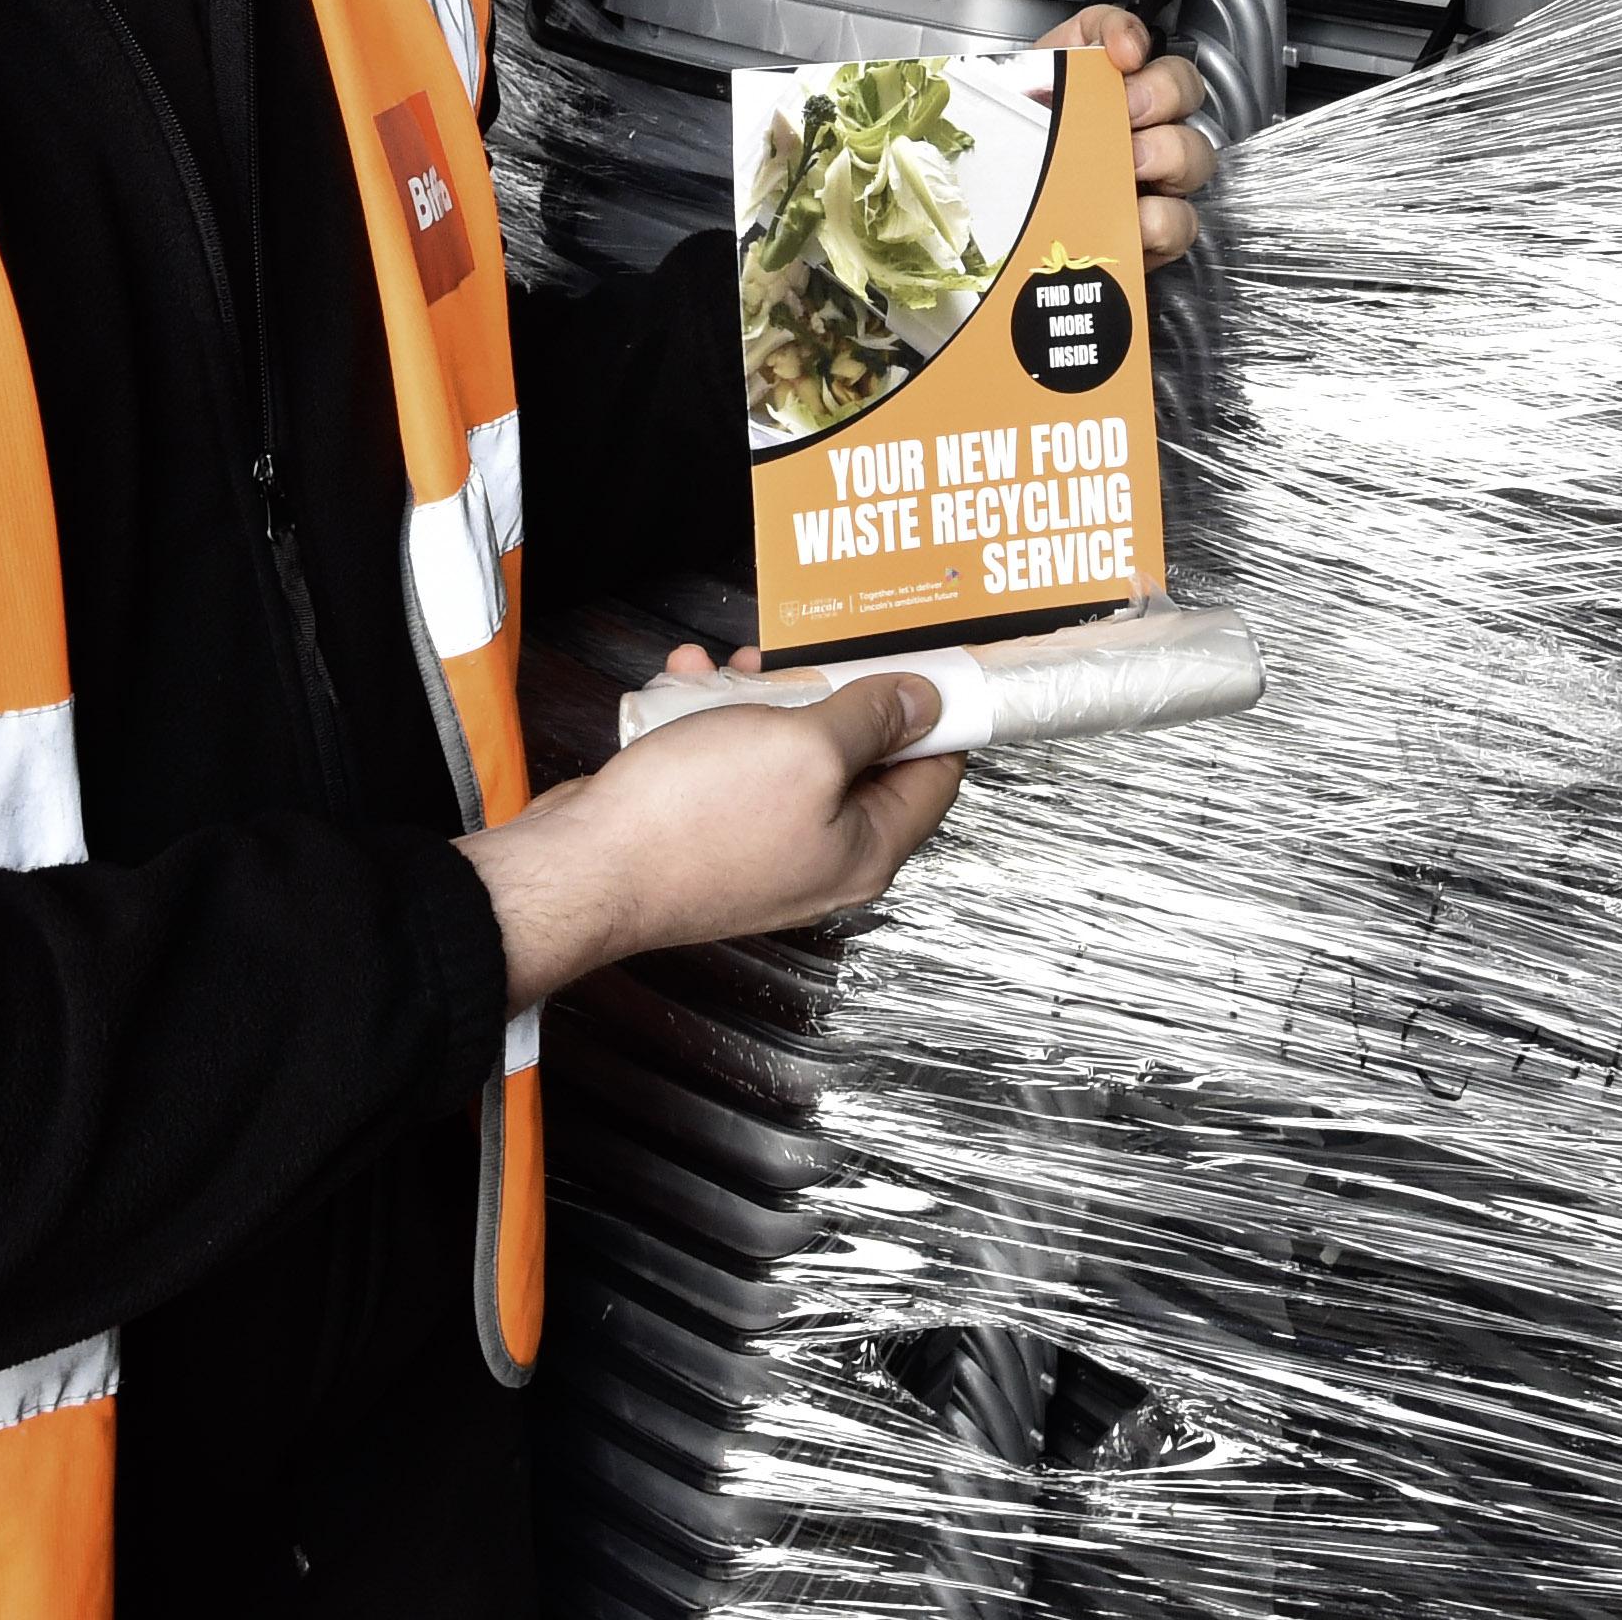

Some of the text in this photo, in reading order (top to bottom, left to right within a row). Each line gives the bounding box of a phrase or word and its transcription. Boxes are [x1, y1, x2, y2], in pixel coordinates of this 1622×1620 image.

[1036, 282, 1102, 308] FIND OUT
[1049, 313, 1094, 337] MORE
[1048, 343, 1098, 369] INSIDE
[827, 417, 1129, 501] YOUR NEW FOOD
[792, 472, 1133, 566] WASTE RECYCLING
[982, 527, 1136, 595] SERVICE
[894, 595, 933, 607] ambitious
[934, 591, 958, 601] future
[916, 582, 942, 592] deliver
[801, 598, 843, 616] Lincoln
